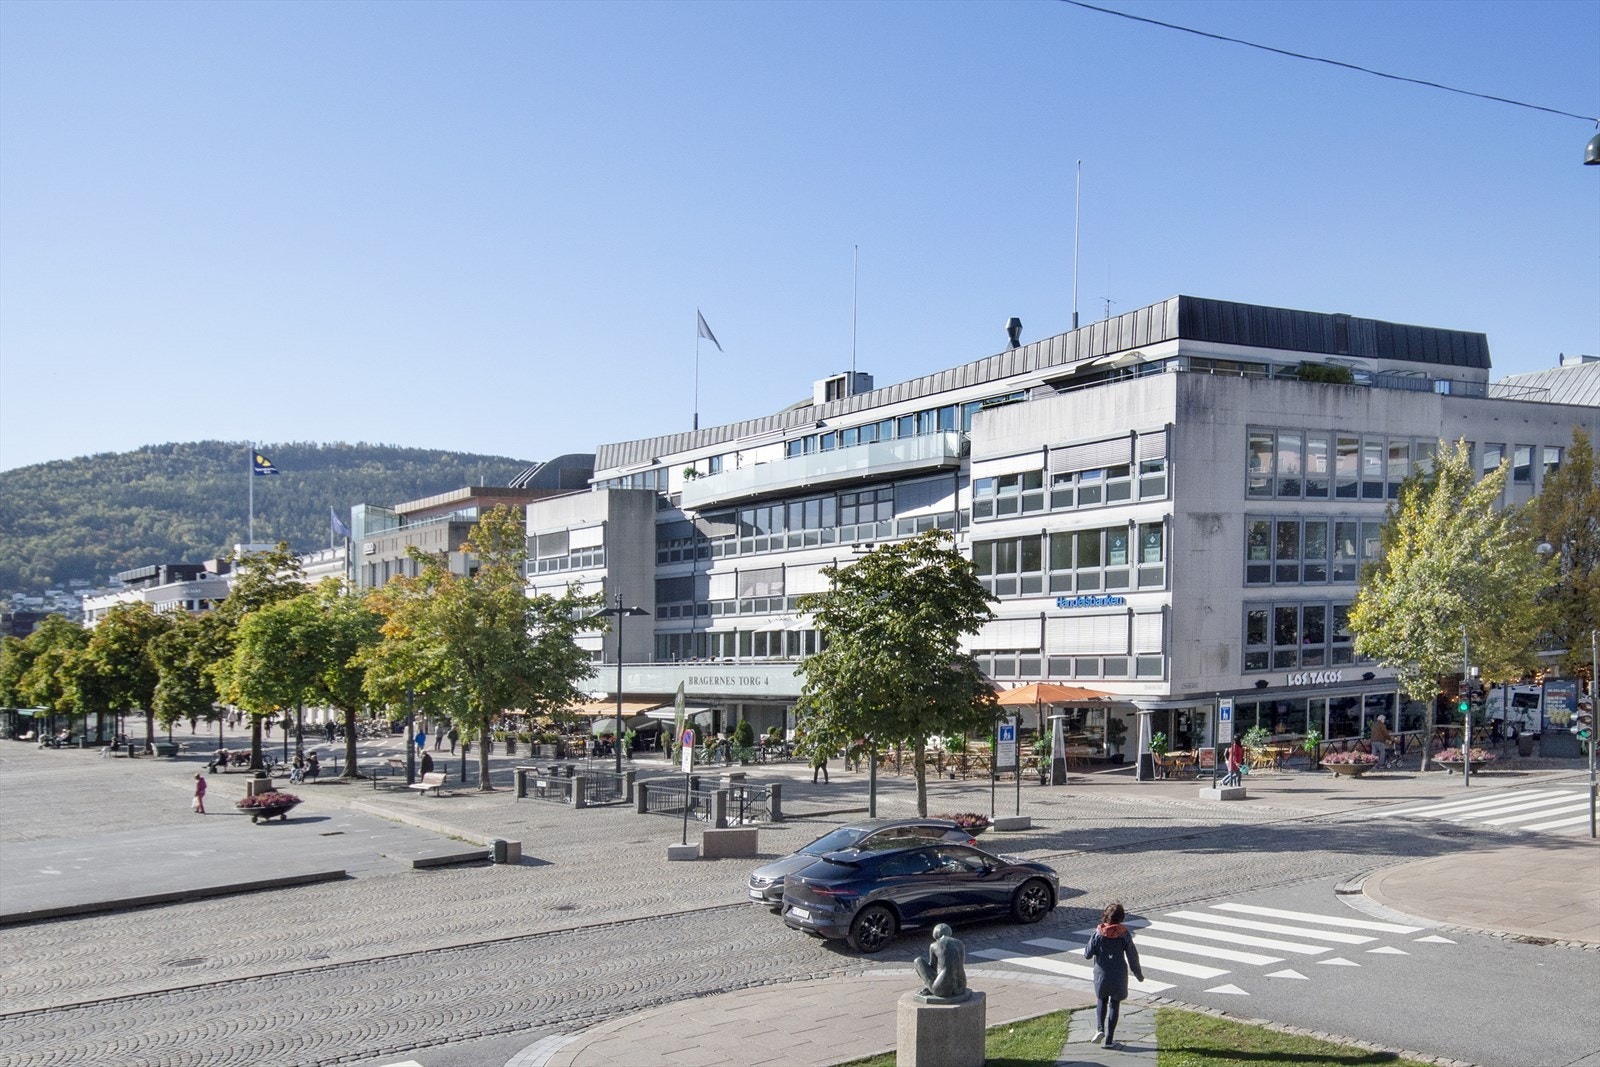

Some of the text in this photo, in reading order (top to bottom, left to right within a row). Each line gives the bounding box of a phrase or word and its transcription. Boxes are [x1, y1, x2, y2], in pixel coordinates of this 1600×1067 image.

[1056, 594, 1125, 609] Handelsbanken
[688, 676, 769, 686] BRAGERNES TORG 4
[1287, 670, 1342, 686] LOS TACOS
